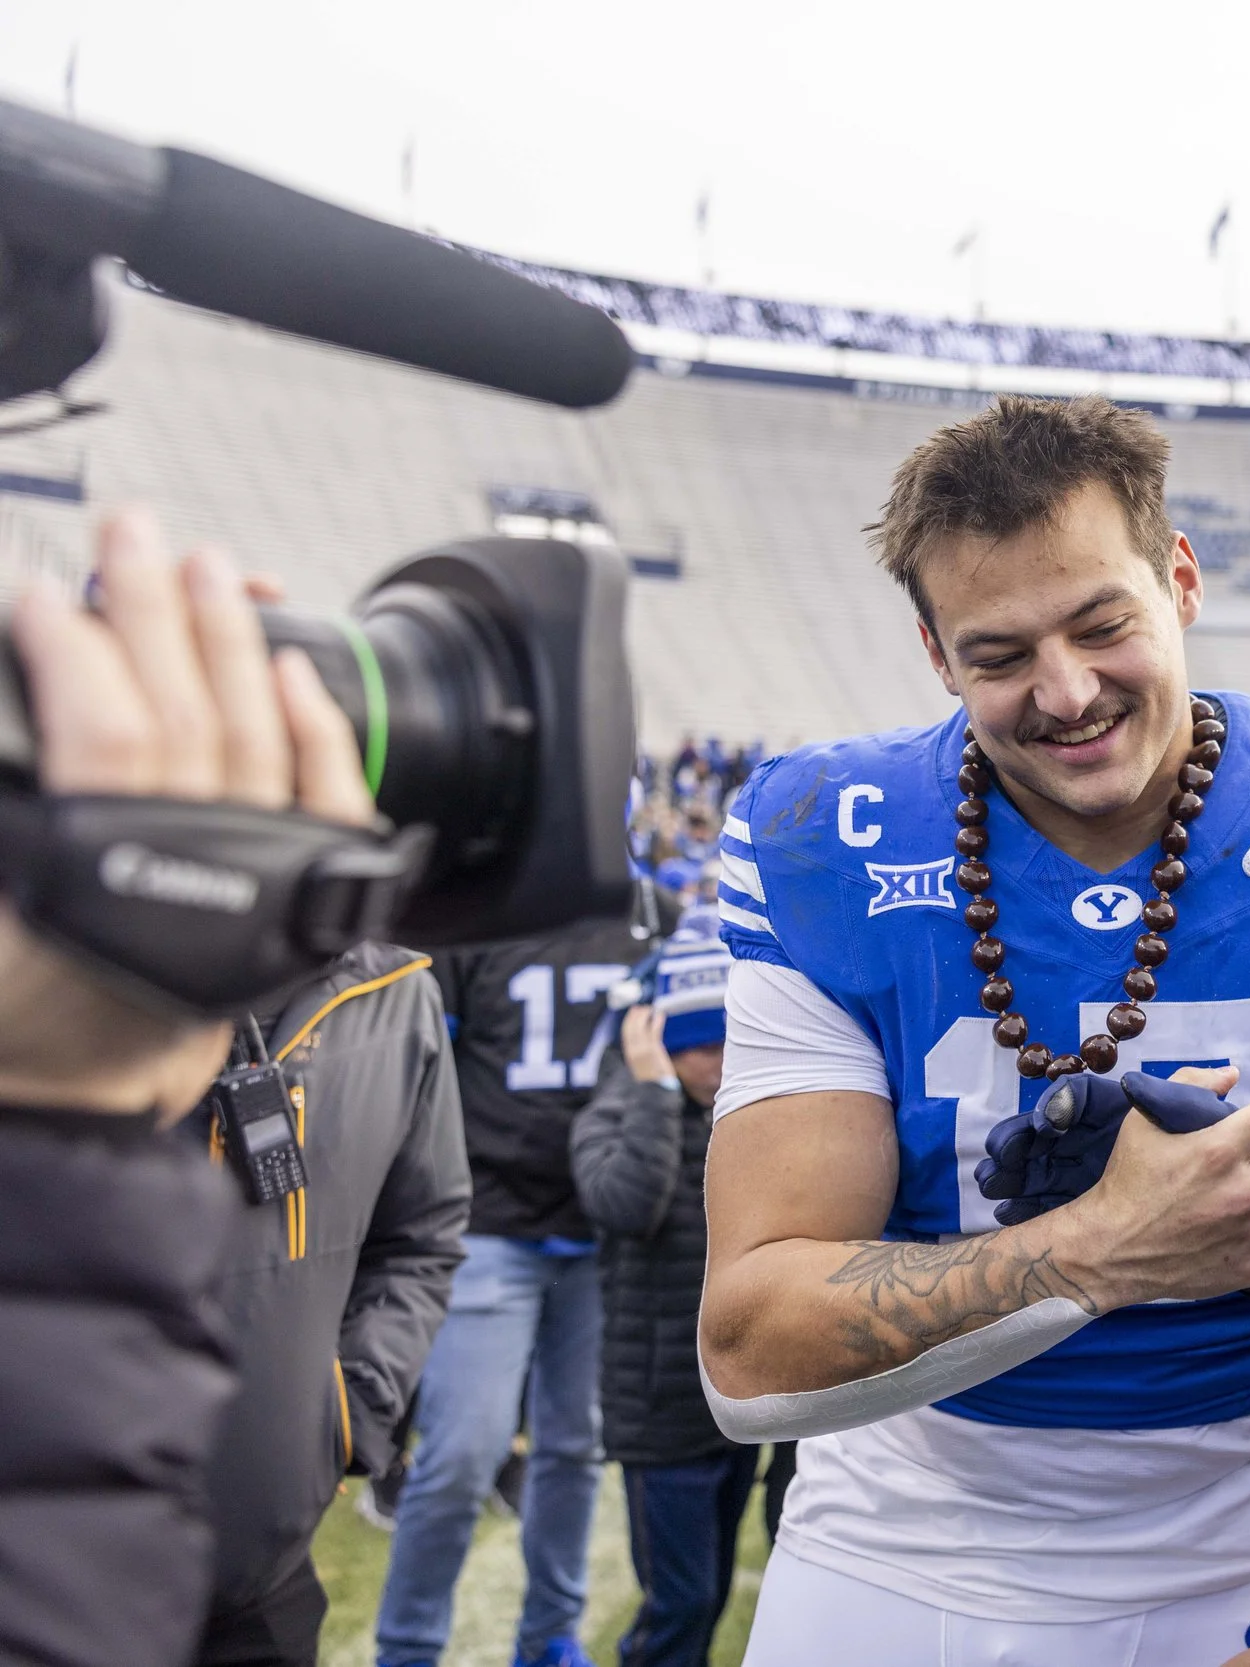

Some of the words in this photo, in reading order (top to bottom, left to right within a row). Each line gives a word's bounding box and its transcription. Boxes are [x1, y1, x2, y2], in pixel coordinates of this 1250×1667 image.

[838, 784, 883, 847] C
[872, 864, 949, 910] XII
[1083, 892, 1128, 923] Y
[507, 963, 632, 1091] 17
